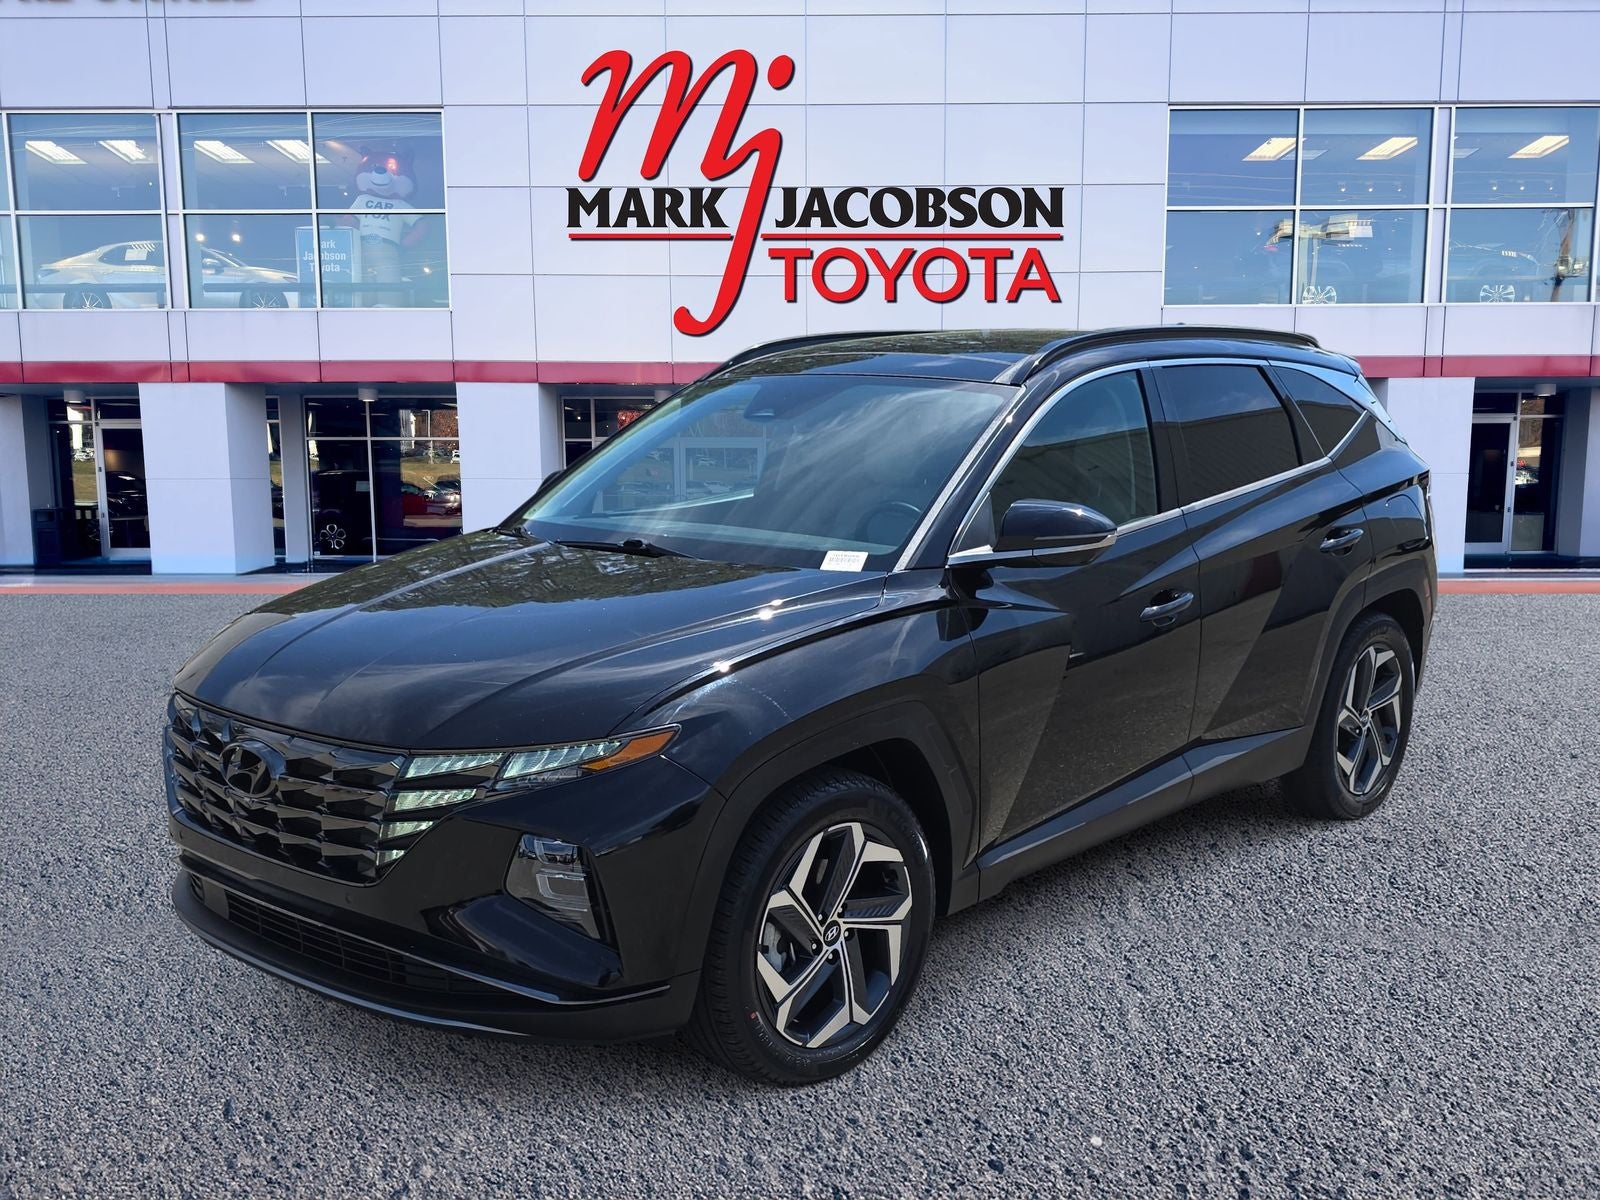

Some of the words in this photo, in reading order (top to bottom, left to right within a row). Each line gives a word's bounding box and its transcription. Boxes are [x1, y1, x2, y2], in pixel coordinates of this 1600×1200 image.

[565, 186, 731, 229] MARK
[774, 186, 1065, 229] JACOBSON
[767, 247, 1063, 304] TOYOTA
